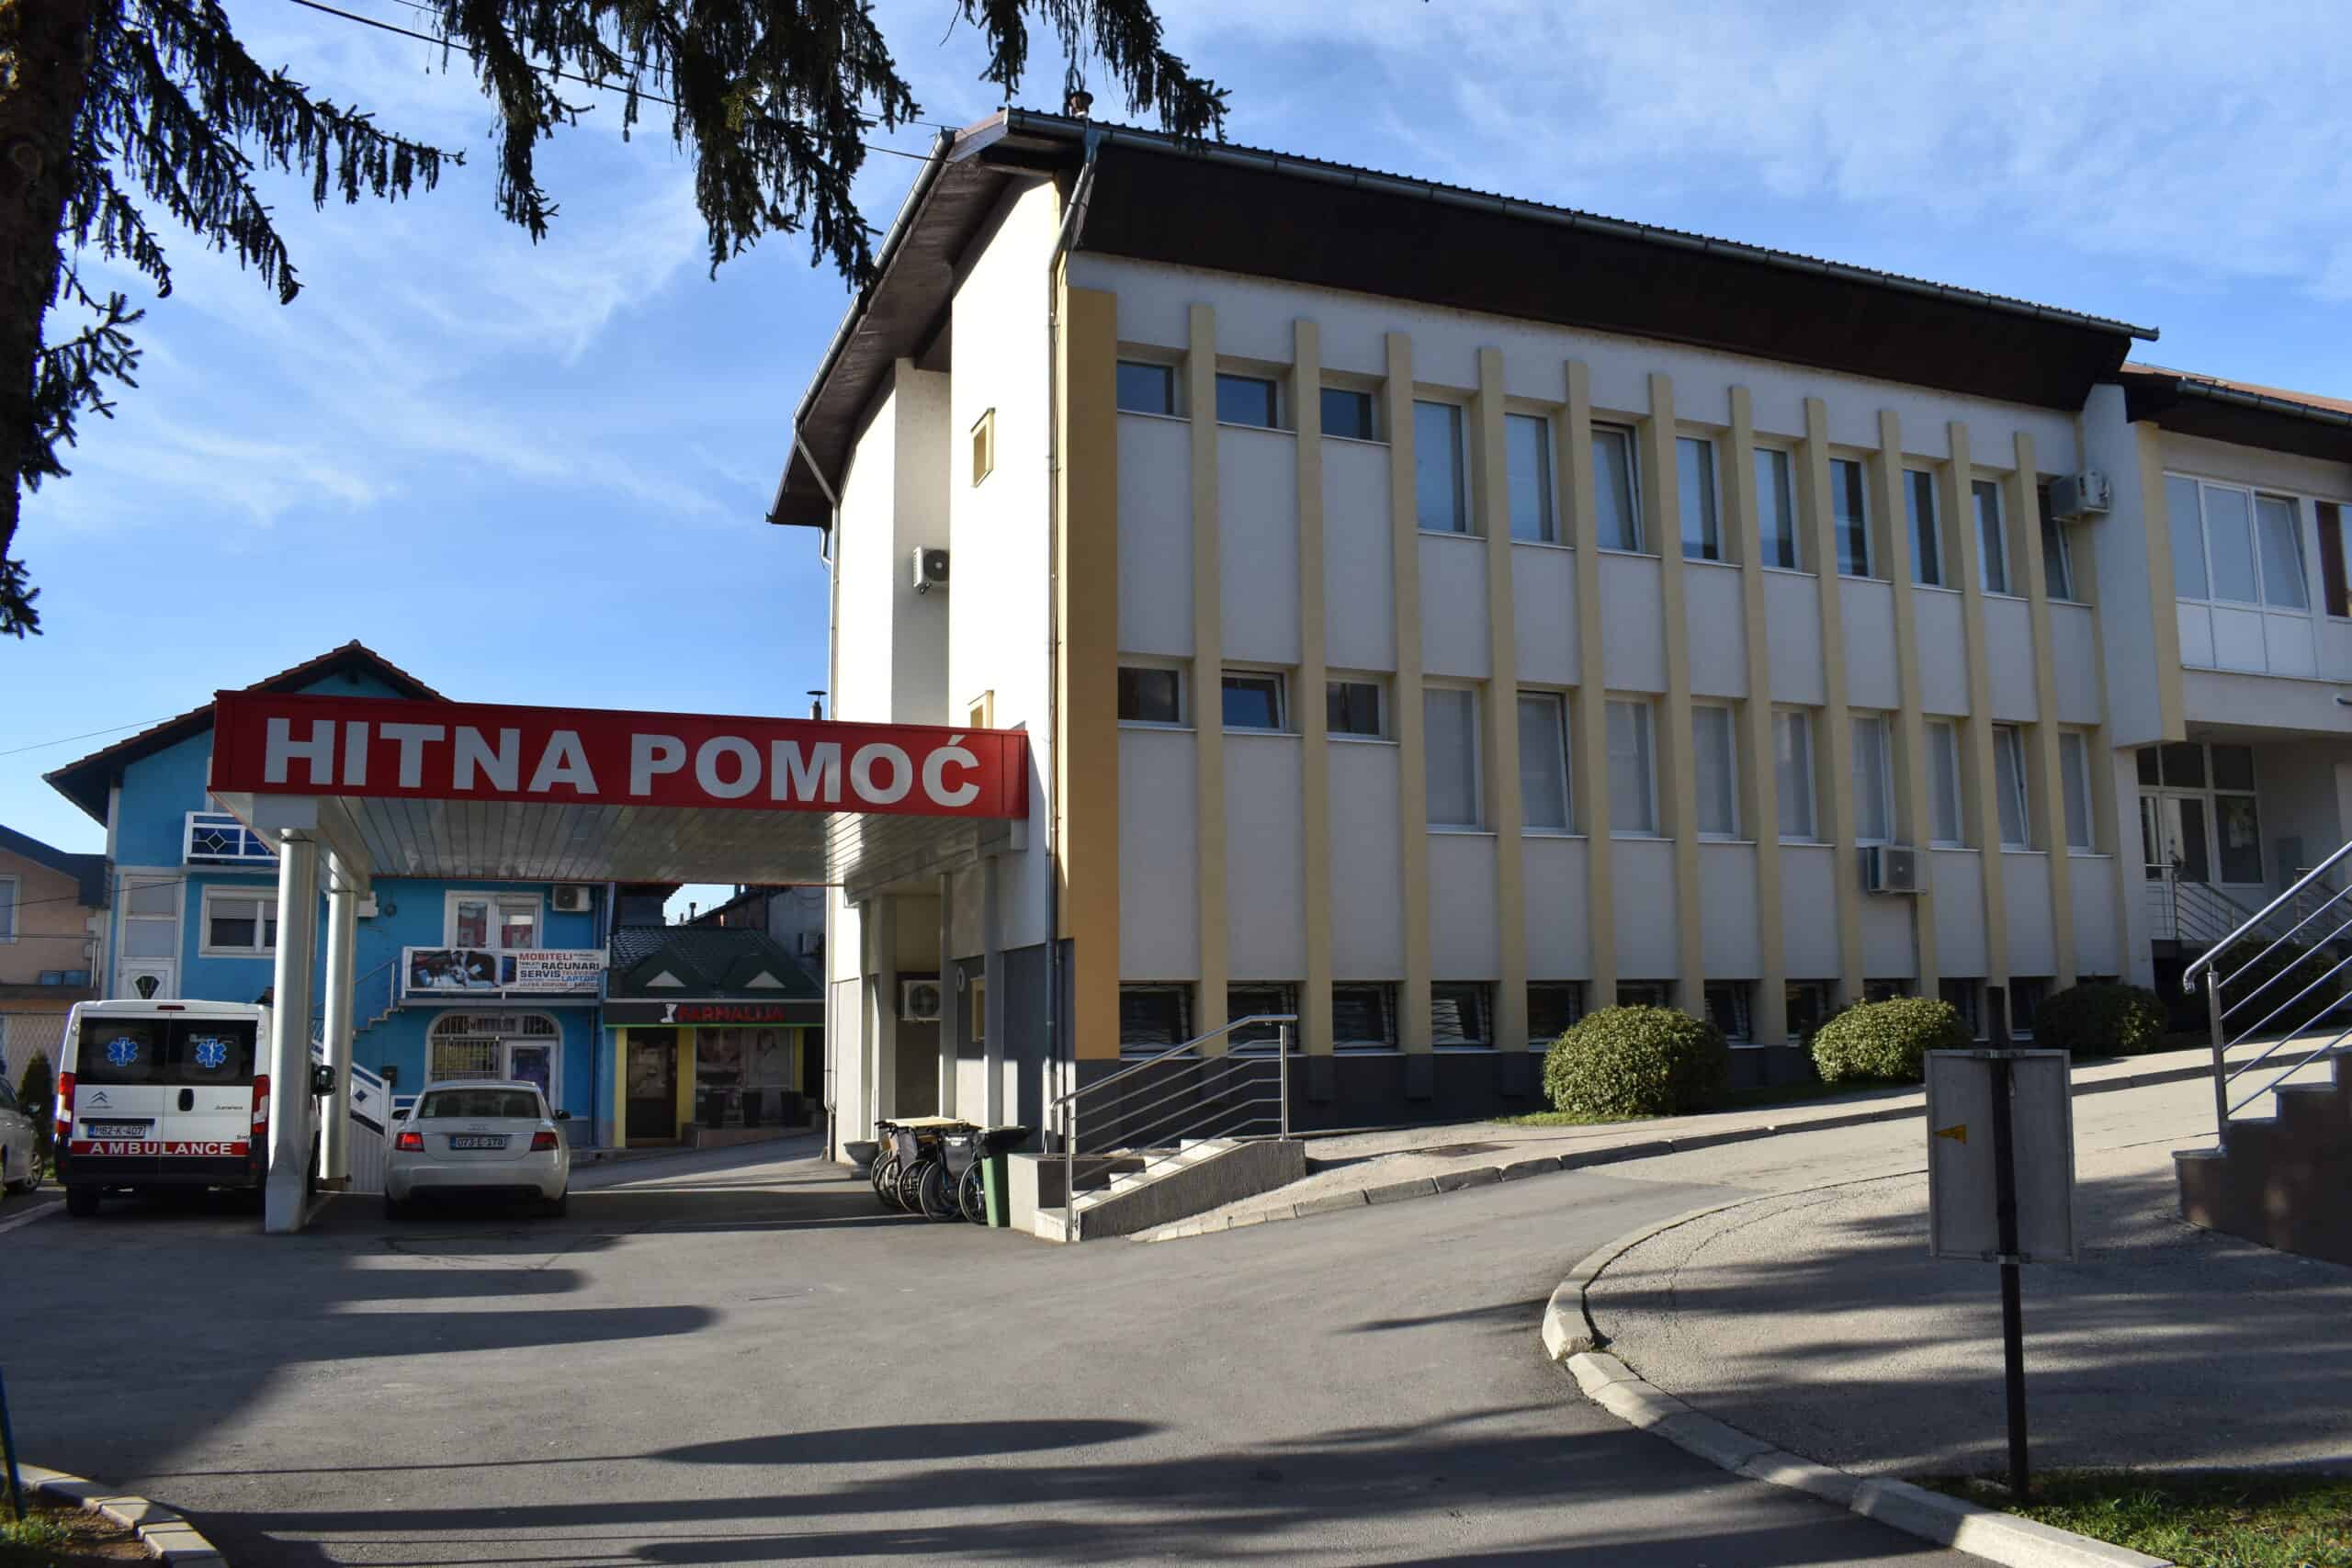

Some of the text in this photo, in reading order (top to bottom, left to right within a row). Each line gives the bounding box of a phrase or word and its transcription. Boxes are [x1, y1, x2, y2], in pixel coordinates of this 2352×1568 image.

[264, 717, 981, 807] HITNA POMOĆ
[519, 953, 572, 961] MOBITELI
[520, 970, 560, 978] SERVIS
[89, 1143, 232, 1155] AMBULANCE
